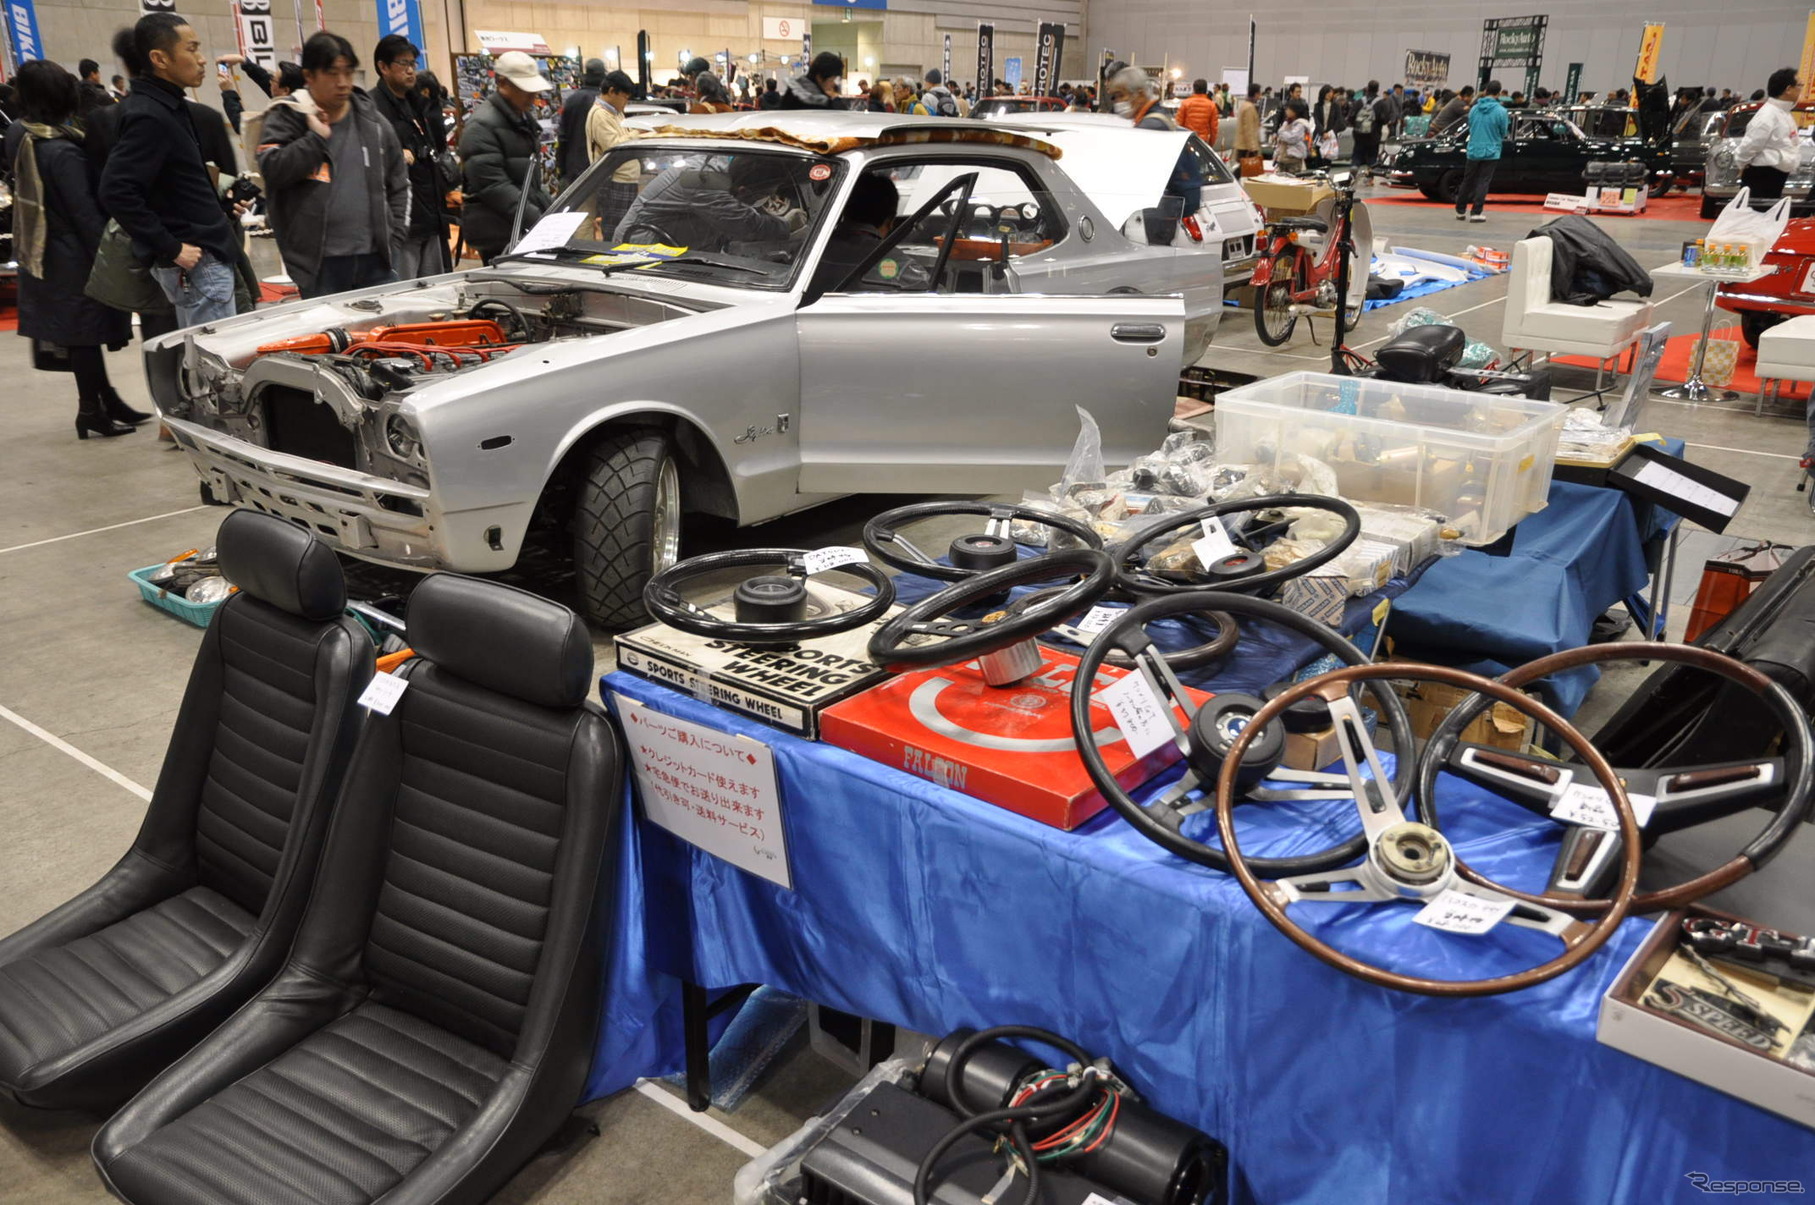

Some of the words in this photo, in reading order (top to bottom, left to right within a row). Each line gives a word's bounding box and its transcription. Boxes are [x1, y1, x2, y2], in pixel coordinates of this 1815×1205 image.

[249, 20, 273, 66] BIL
[704, 640, 850, 685] STEERING
[722, 661, 826, 697] WHEEL
[788, 645, 878, 675] ORTS
[647, 660, 685, 684] SPORTS
[689, 677, 741, 704] SRING
[745, 696, 783, 720] WHEEL
[653, 766, 765, 821] 宅急便でお送り出来ます
[1684, 1000, 1771, 1049] SPEED
